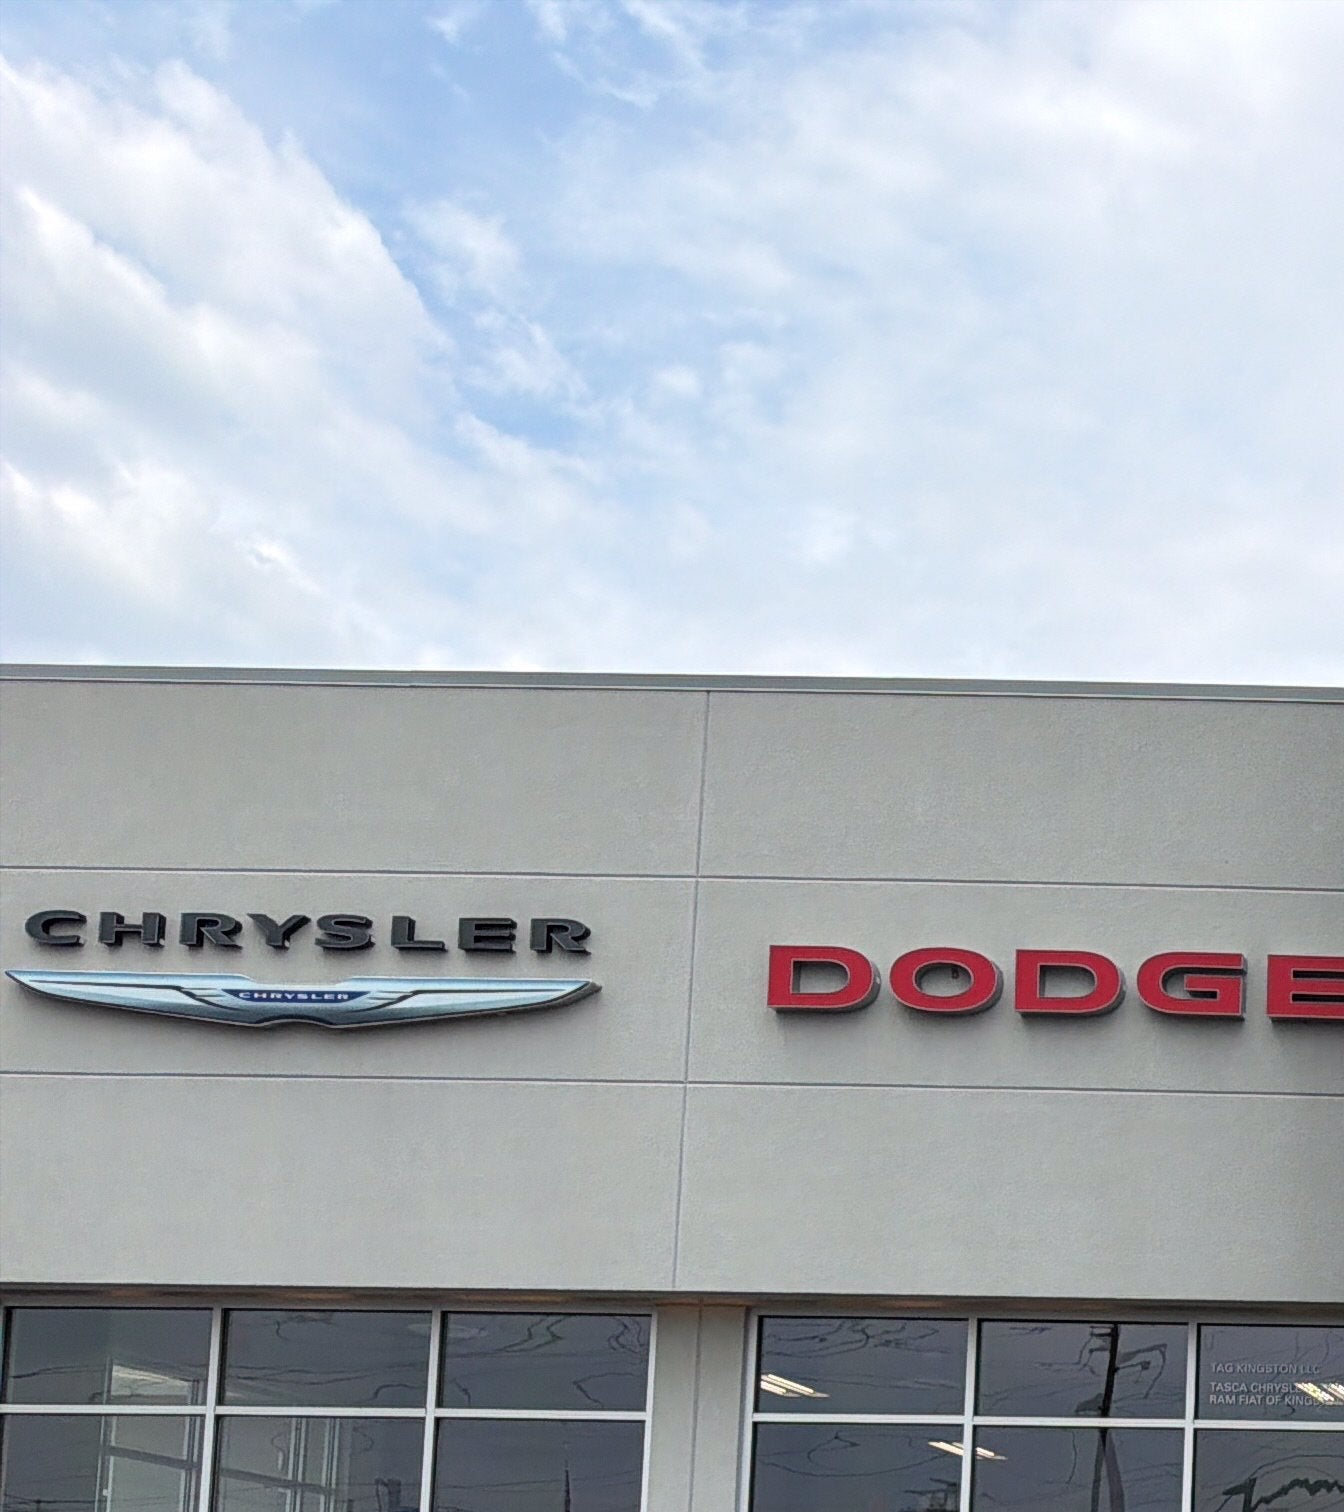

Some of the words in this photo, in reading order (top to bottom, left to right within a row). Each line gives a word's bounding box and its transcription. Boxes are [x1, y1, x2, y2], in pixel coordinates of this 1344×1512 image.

[25, 909, 593, 954] CHRYSLER
[239, 992, 349, 1001] CHRYSLER
[1211, 1363, 1233, 1374] TAG
[1236, 1363, 1297, 1374] KINGSTON
[1210, 1382, 1247, 1392] TASCA
[1251, 1382, 1316, 1393] CHRYSL
[1209, 1394, 1236, 1405] RAM
[1239, 1395, 1264, 1405] FIAT
[1266, 1395, 1281, 1405] OF
